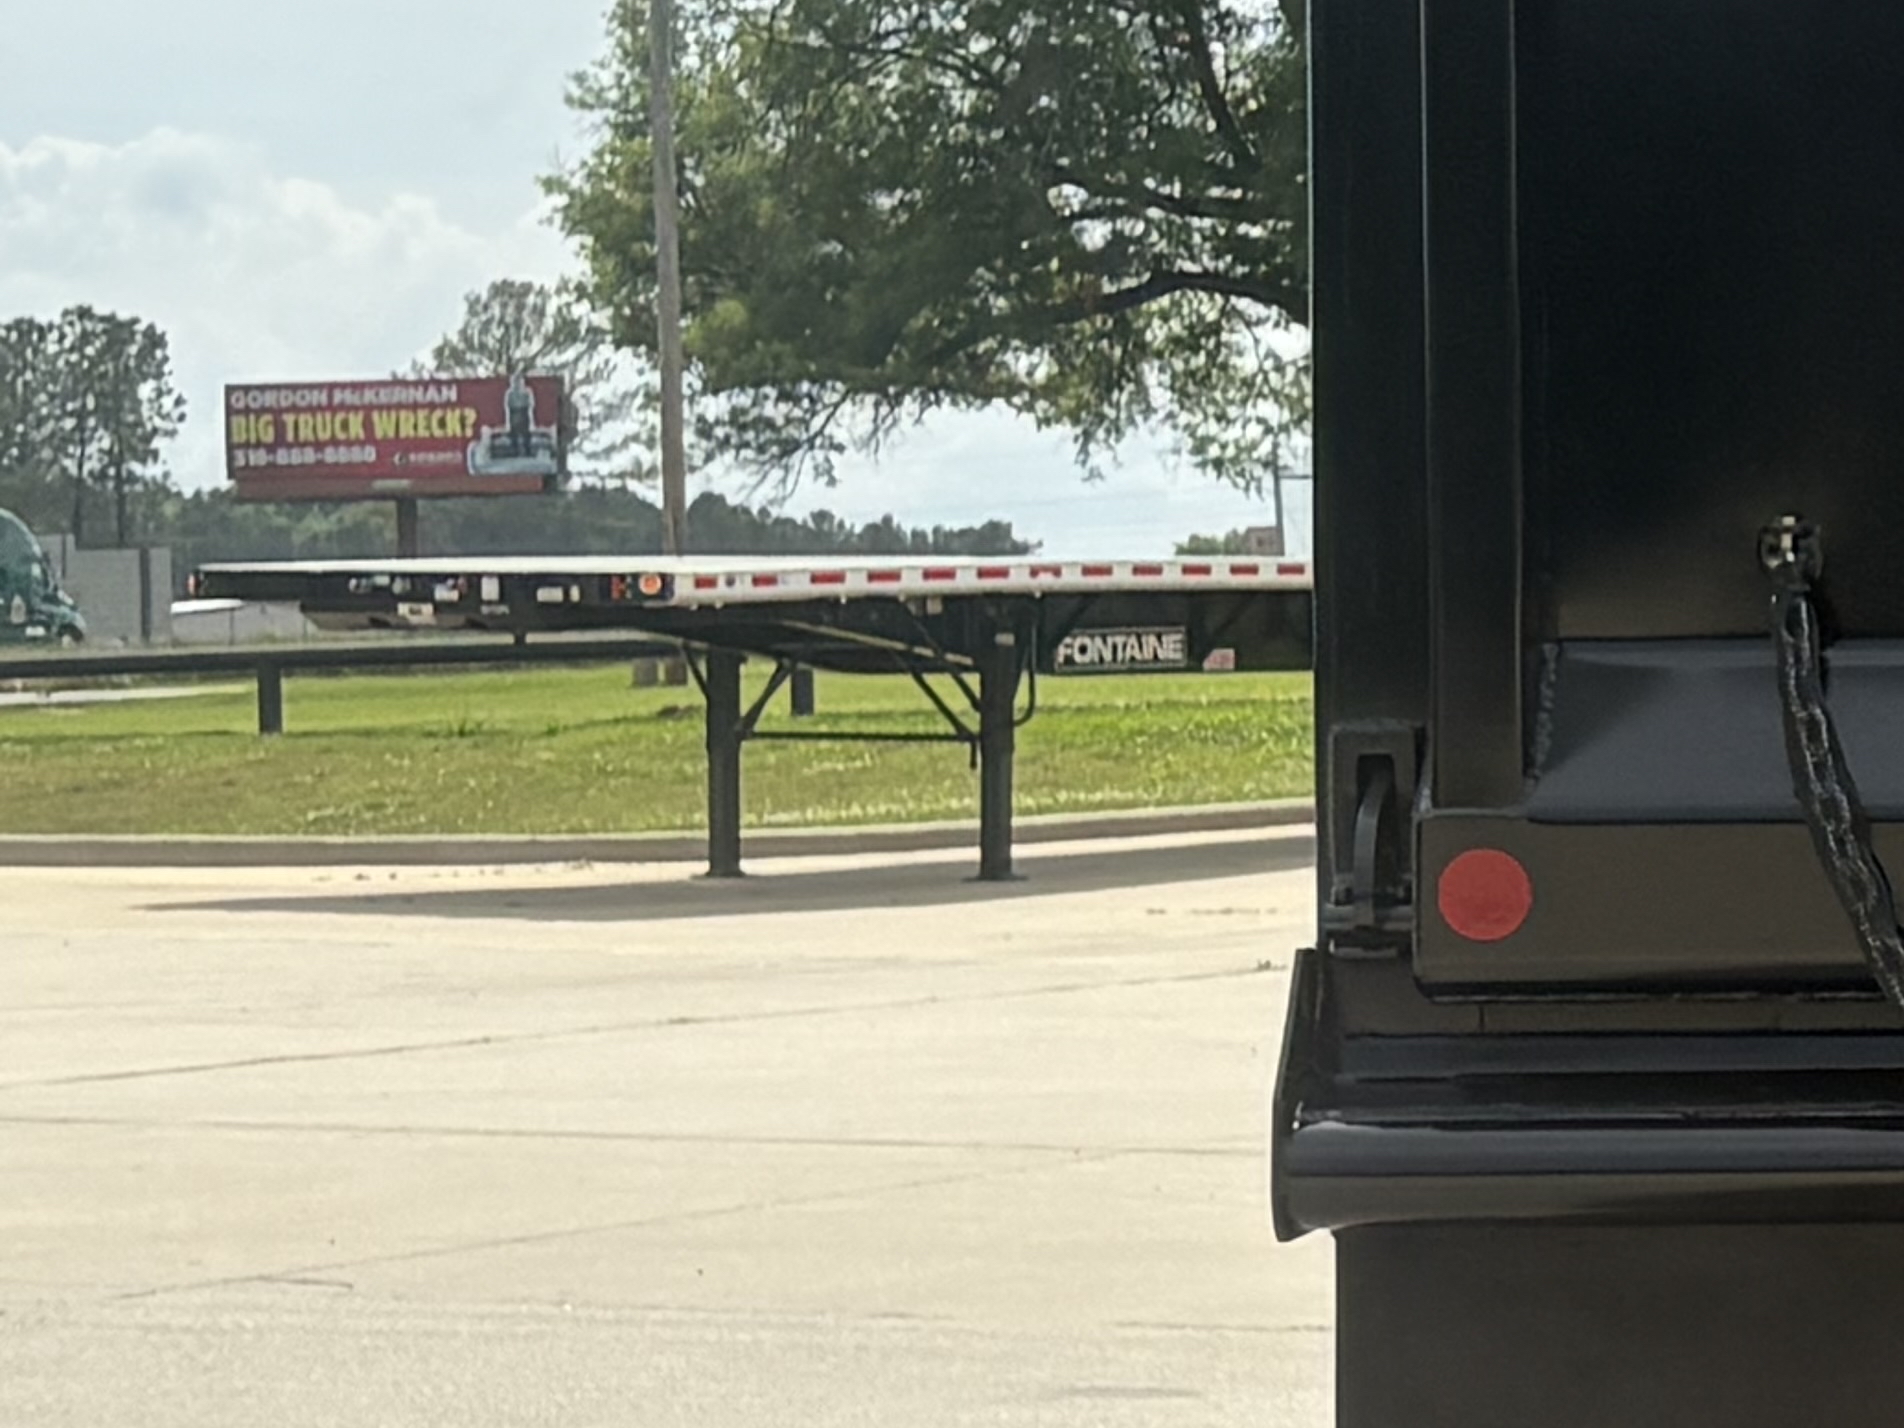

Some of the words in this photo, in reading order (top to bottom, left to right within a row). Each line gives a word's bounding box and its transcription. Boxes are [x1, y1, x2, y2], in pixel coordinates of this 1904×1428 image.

[231, 389, 328, 409] GORDON
[231, 413, 275, 444] BIG
[282, 410, 365, 443] TRUCK
[372, 407, 477, 440] WRECK?
[1057, 632, 1185, 664] FONTAINE
